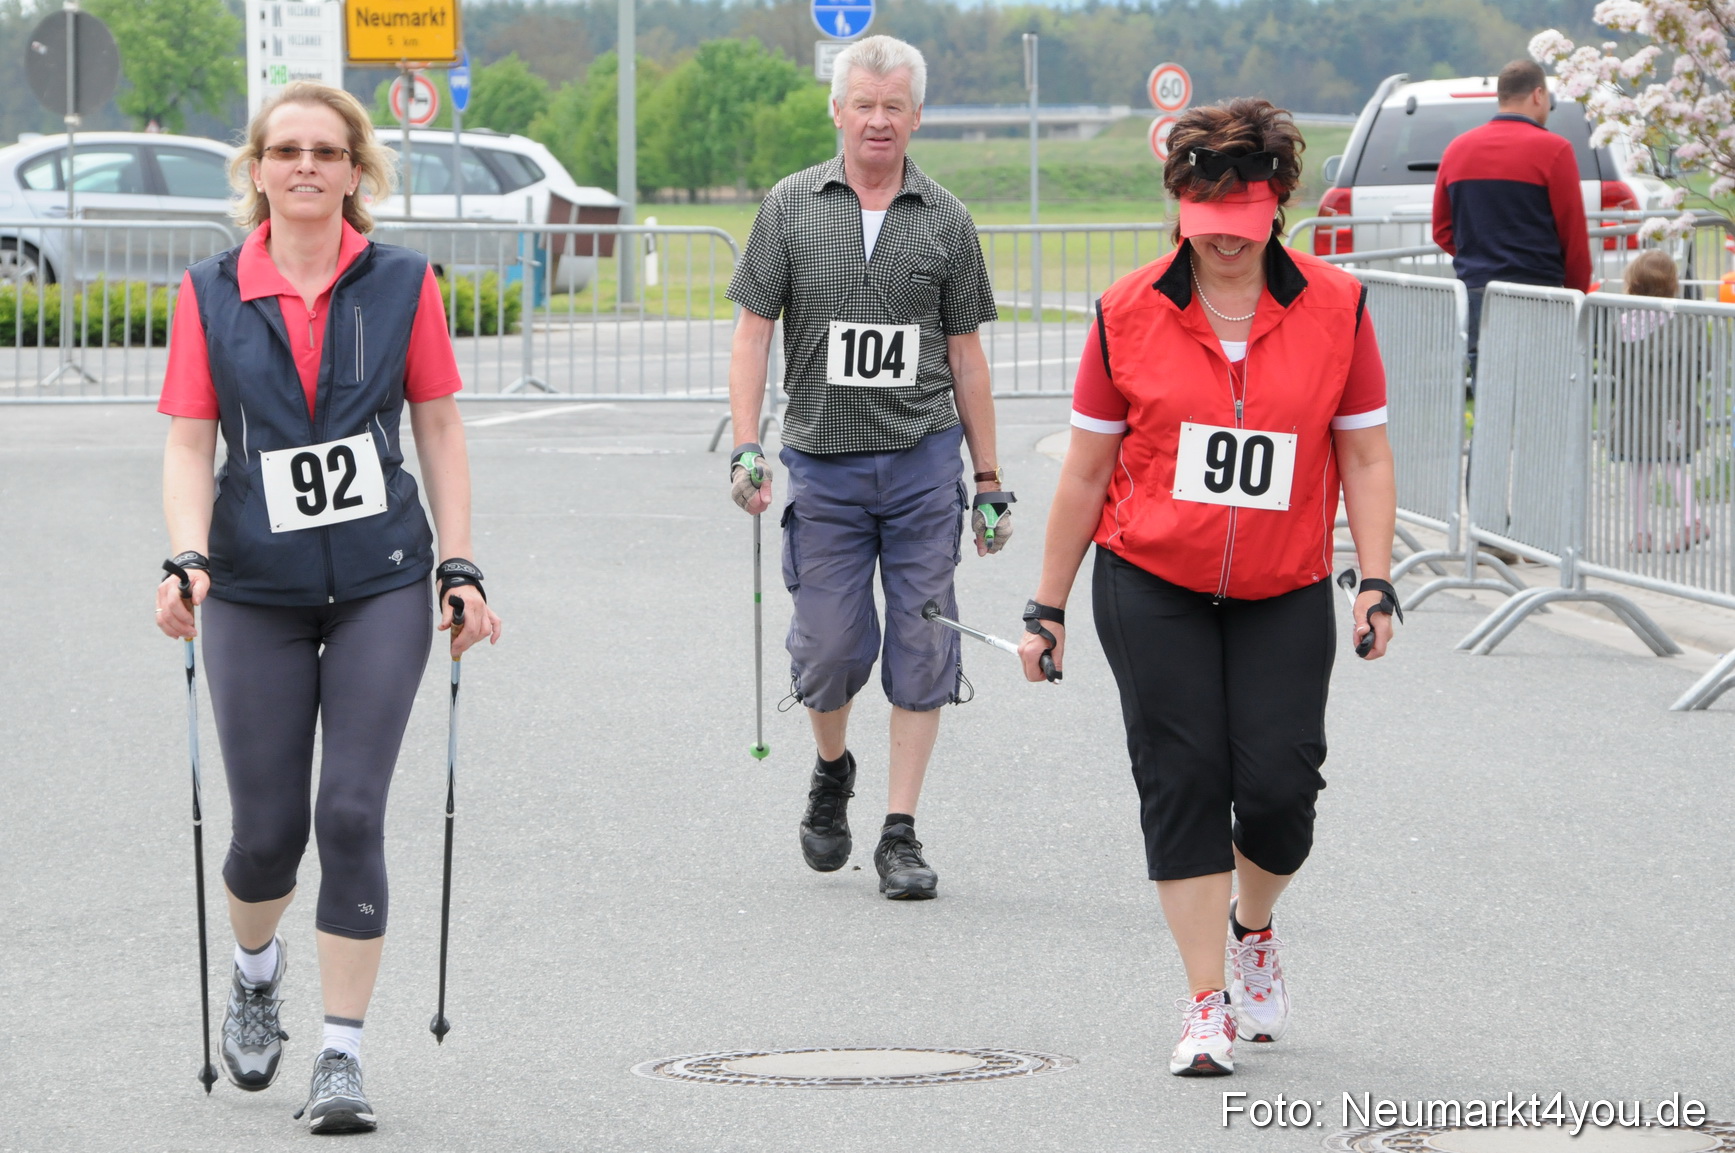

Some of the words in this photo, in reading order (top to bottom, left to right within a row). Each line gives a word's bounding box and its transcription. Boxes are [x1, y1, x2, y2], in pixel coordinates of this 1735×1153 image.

[356, 6, 447, 27] Neumarkt
[403, 35, 419, 46] km
[1160, 77, 1182, 99] 60
[841, 328, 905, 379] 104
[290, 444, 364, 517] 92
[1204, 431, 1274, 497] 90
